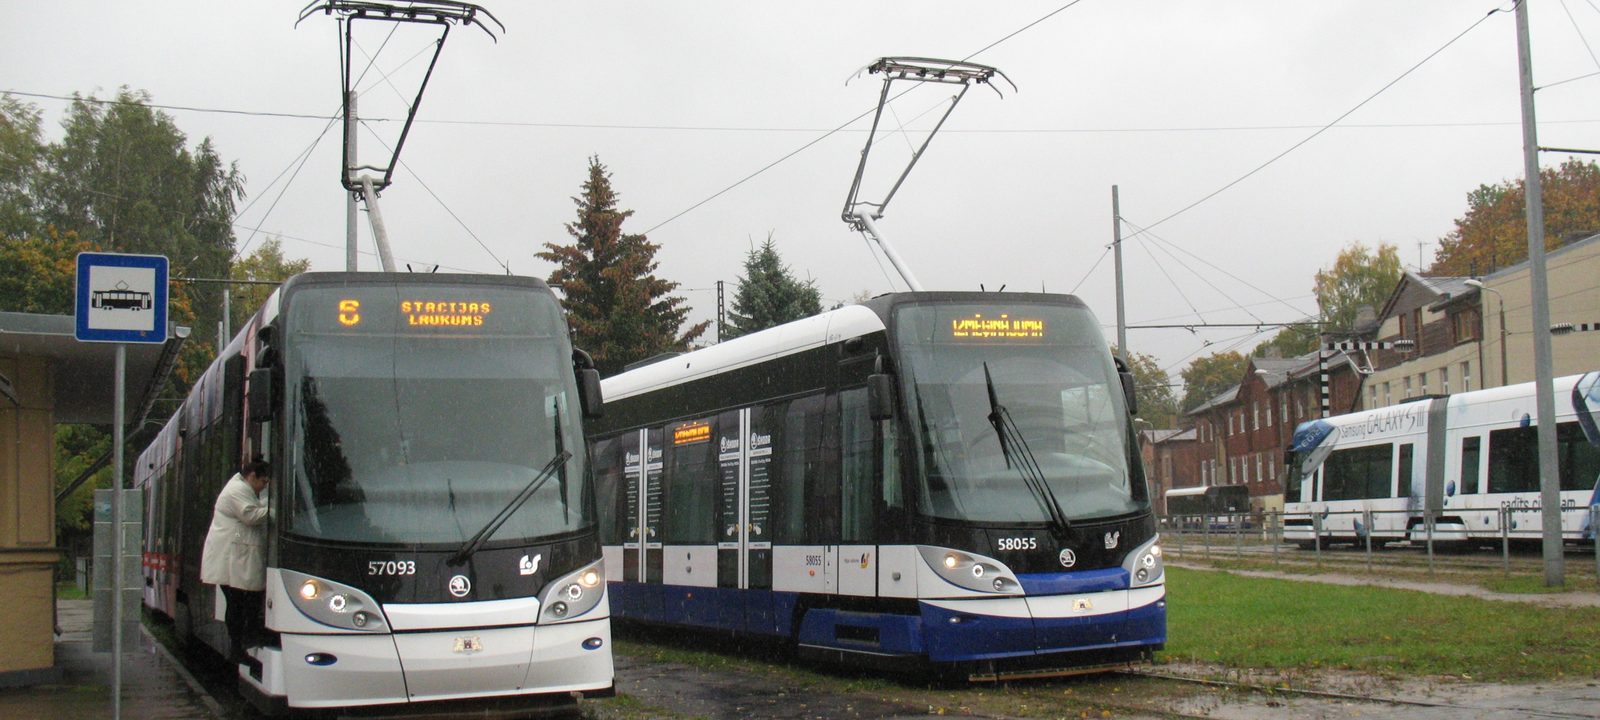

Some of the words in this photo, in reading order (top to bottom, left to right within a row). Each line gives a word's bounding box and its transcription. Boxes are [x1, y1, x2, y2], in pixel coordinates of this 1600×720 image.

[339, 300, 360, 325] 6
[402, 301, 491, 314] STACIJAS
[409, 314, 484, 326] LAUKUMS
[1341, 424, 1366, 439] Samsung
[1367, 409, 1406, 434] GALAXY
[998, 537, 1037, 550] 58055
[806, 555, 821, 566] 58055
[368, 561, 416, 576] 57093
